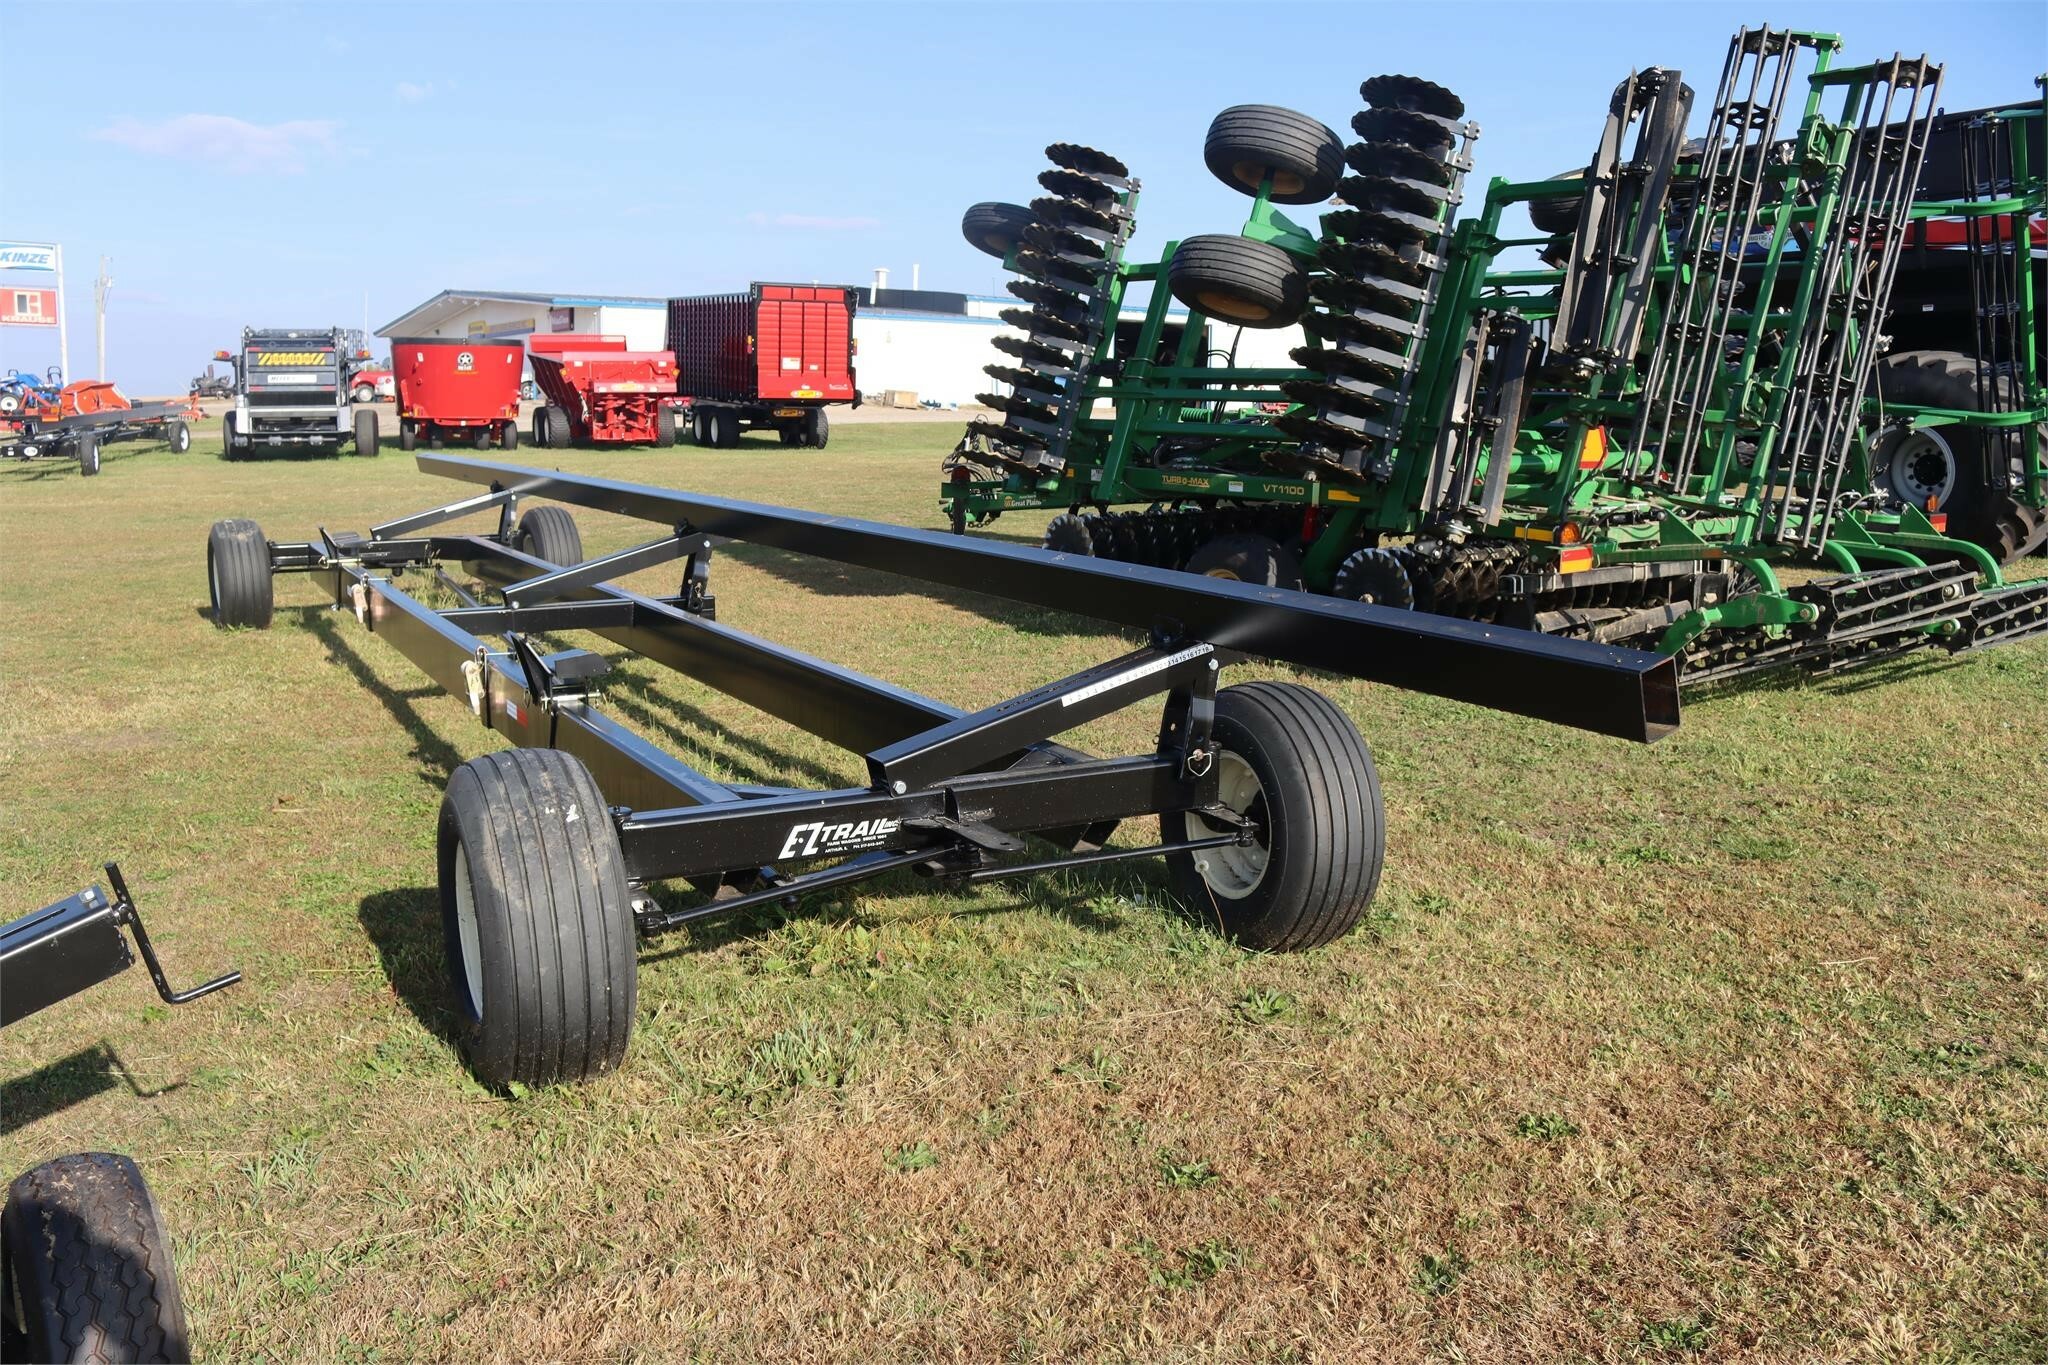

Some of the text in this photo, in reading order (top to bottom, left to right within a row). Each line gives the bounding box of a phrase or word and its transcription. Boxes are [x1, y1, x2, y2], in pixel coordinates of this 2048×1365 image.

[0, 251, 50, 264] KINZE
[1, 315, 55, 323] KRAUSE
[1162, 475, 1209, 486] TURBO-MAX
[1263, 484, 1304, 495] VT1100
[820, 818, 897, 843] TRAIL
